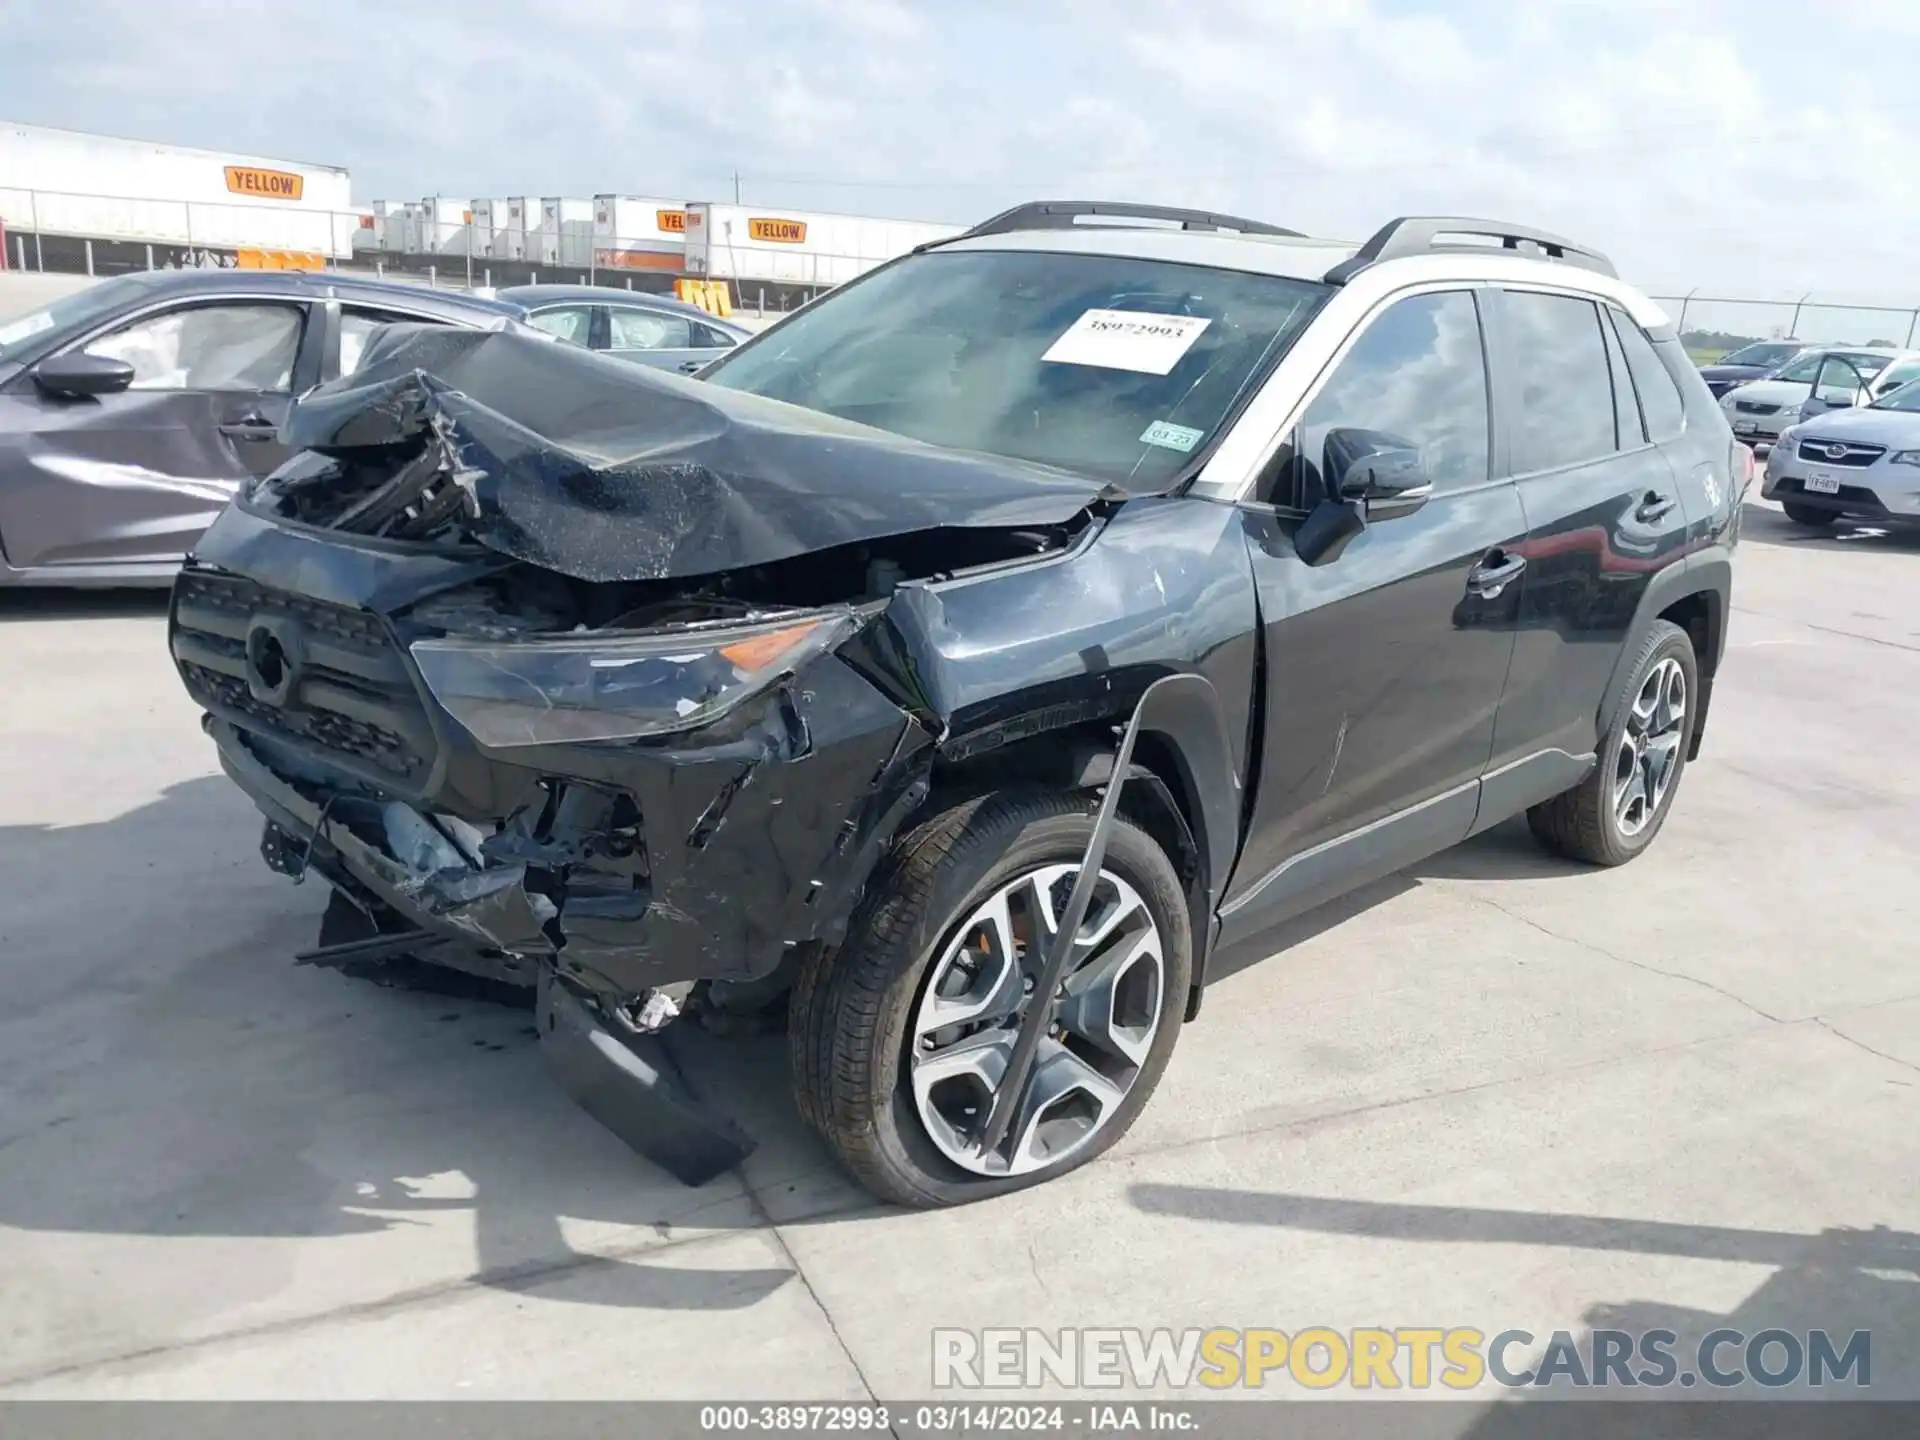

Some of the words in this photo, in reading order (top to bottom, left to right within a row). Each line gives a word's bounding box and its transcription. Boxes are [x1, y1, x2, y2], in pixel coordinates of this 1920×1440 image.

[234, 171, 294, 194] YELLOW
[664, 213, 684, 229] YEL
[755, 222, 801, 239] YELLOW
